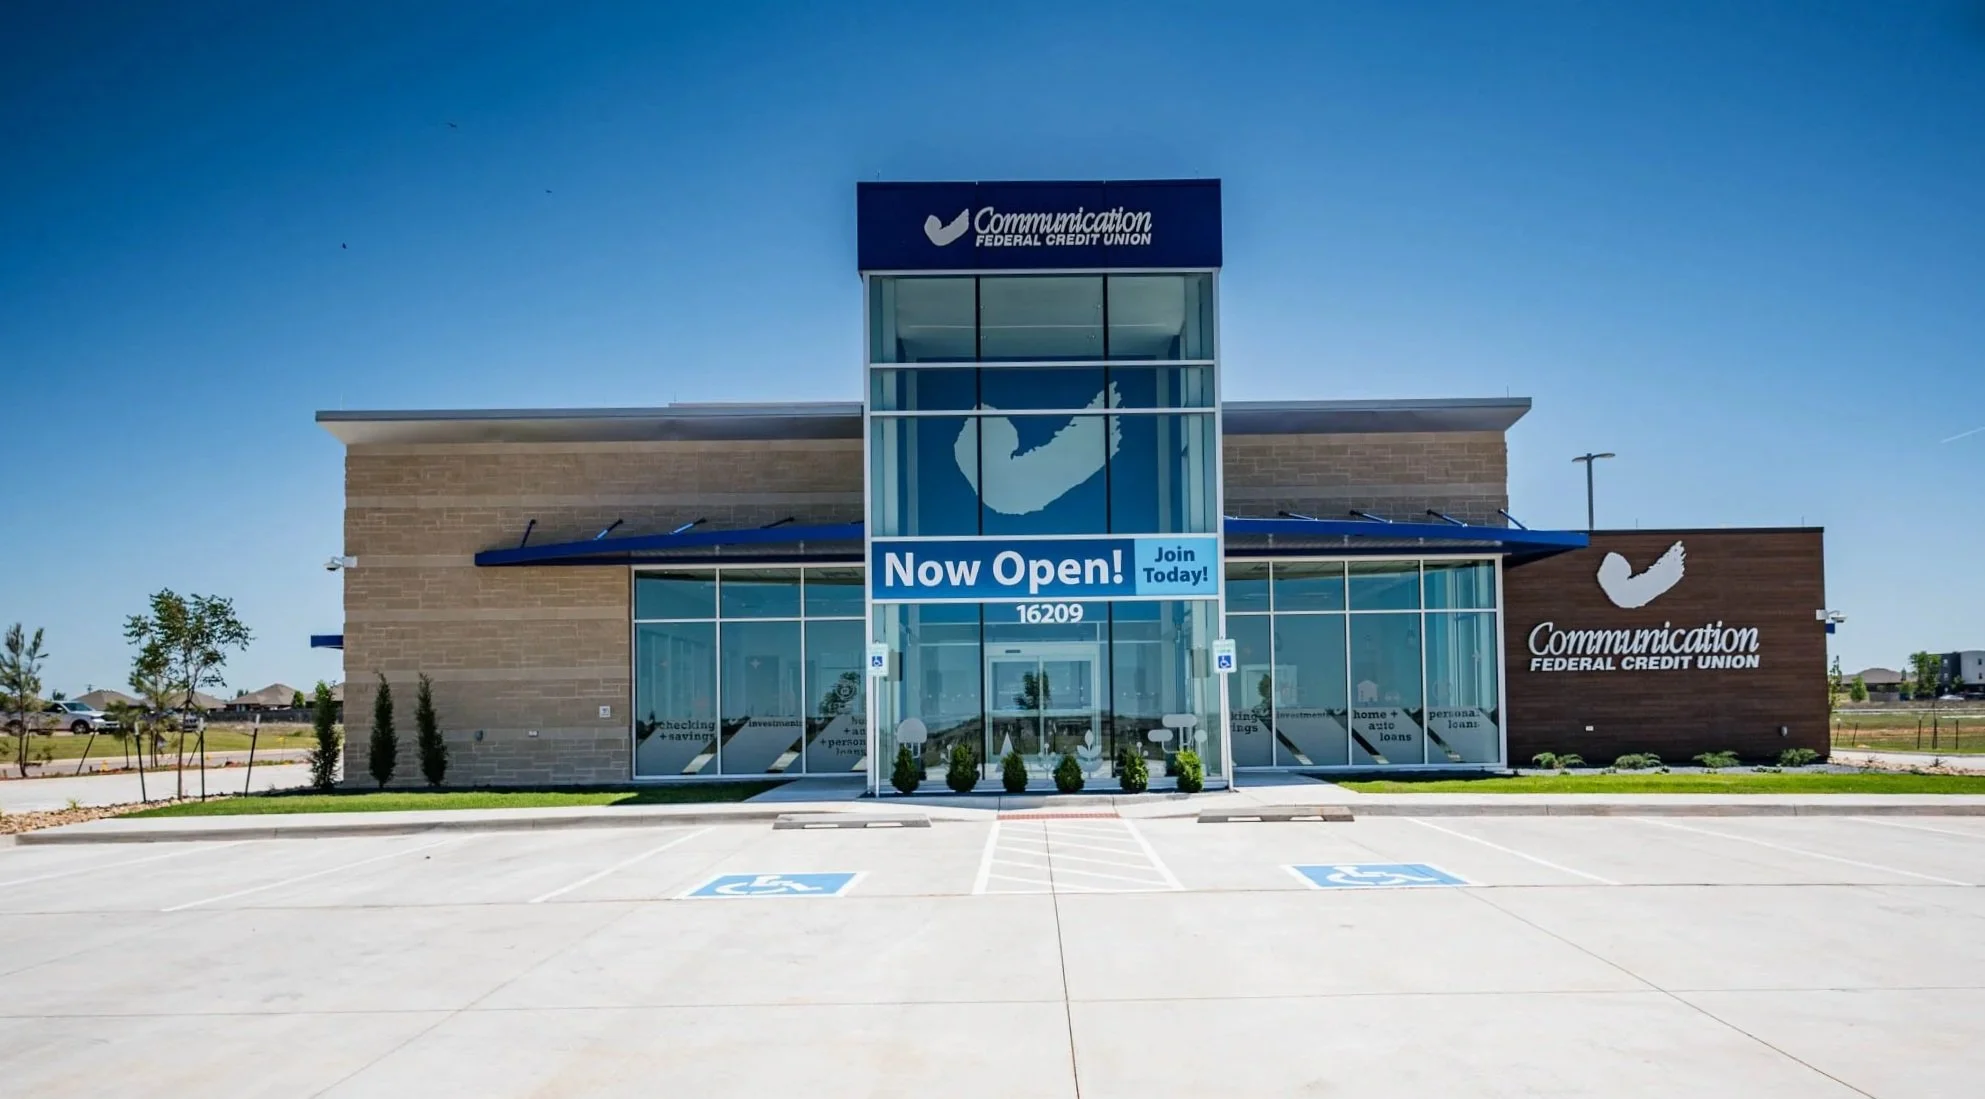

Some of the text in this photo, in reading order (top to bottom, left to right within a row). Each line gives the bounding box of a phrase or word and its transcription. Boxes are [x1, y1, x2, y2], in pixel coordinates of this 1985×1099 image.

[974, 206, 1152, 234] Communication
[976, 233, 1152, 247] FEDERAL CREDIT UNION
[1154, 547, 1195, 563] Join
[884, 549, 1123, 595] Now Open!
[1142, 567, 1209, 586] Today!
[1016, 603, 1084, 624] 16209
[1528, 620, 1760, 656] Communication
[1530, 654, 1760, 671] FEDERAL CREDIT UNION
[1353, 709, 1387, 719] home
[659, 719, 716, 732] checking
[1368, 721, 1395, 730] auto
[1379, 732, 1412, 741] loans
